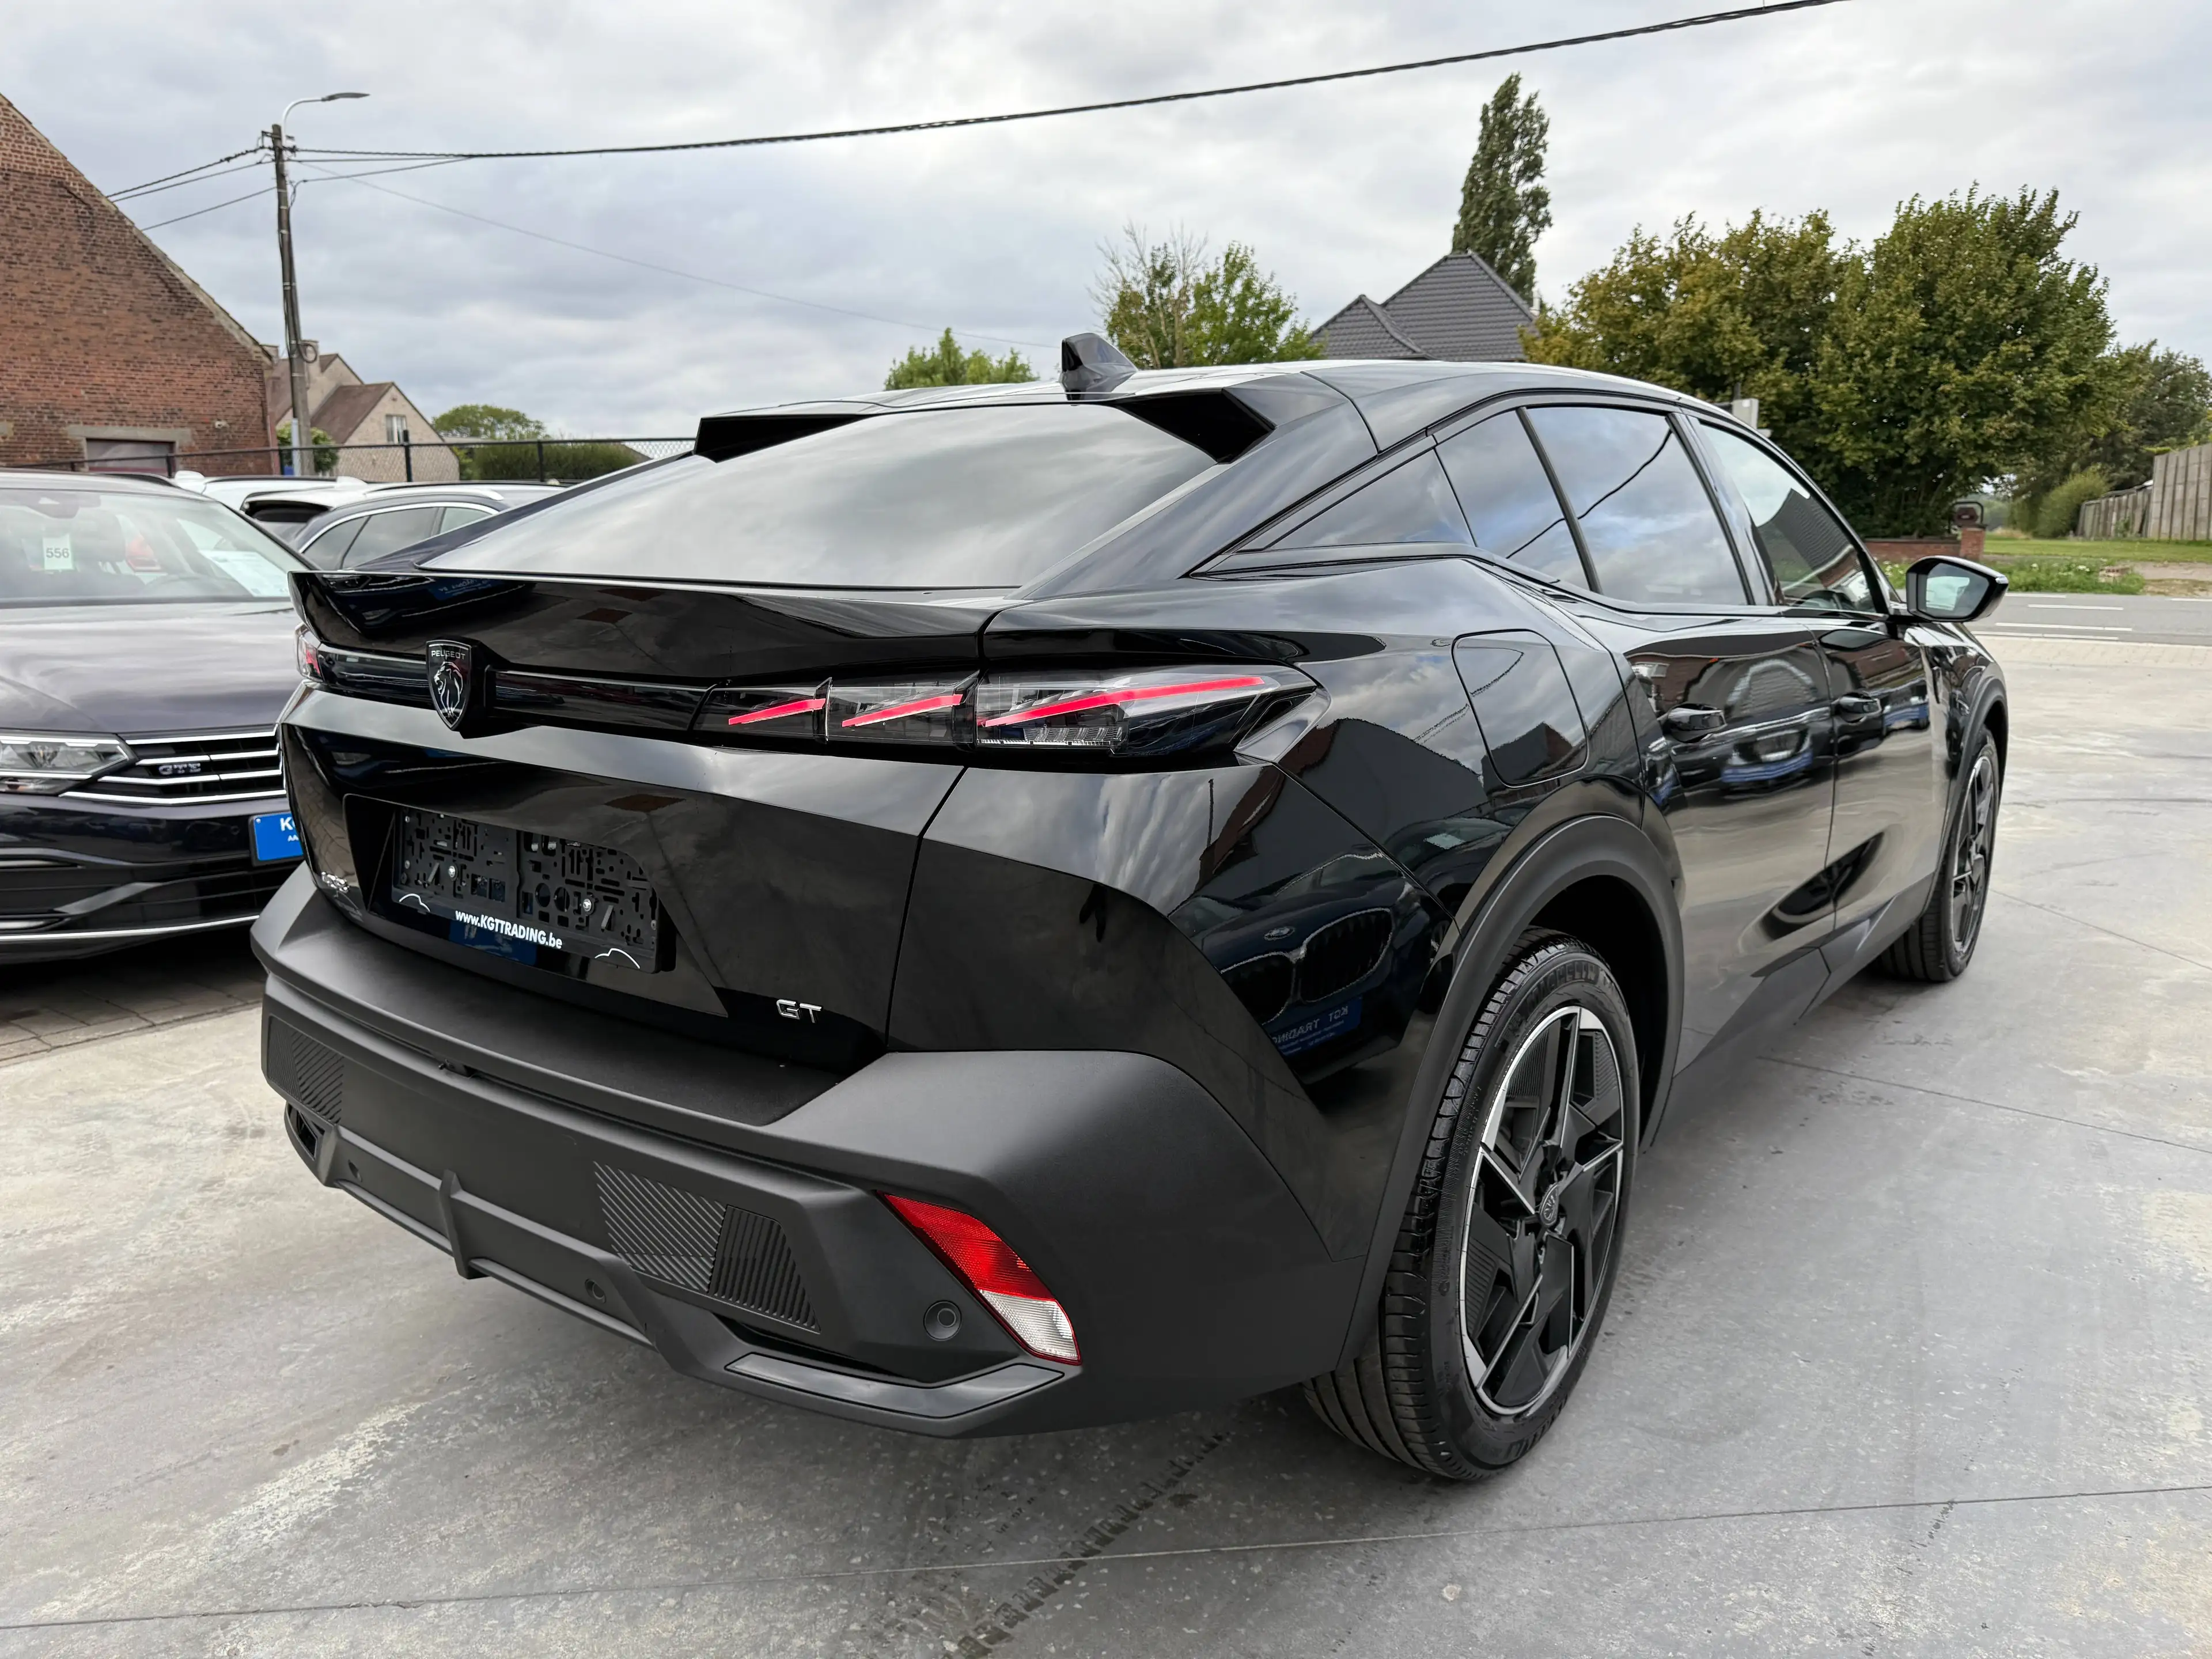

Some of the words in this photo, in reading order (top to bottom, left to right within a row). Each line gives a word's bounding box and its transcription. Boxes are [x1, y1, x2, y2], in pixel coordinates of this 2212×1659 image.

[46, 547, 70, 559] 556
[431, 650, 465, 660] PEUGEOT
[455, 910, 563, 949] www.KGTTRADING.be
[1528, 961, 1596, 1007] MICHELIN
[777, 999, 822, 1023] GT
